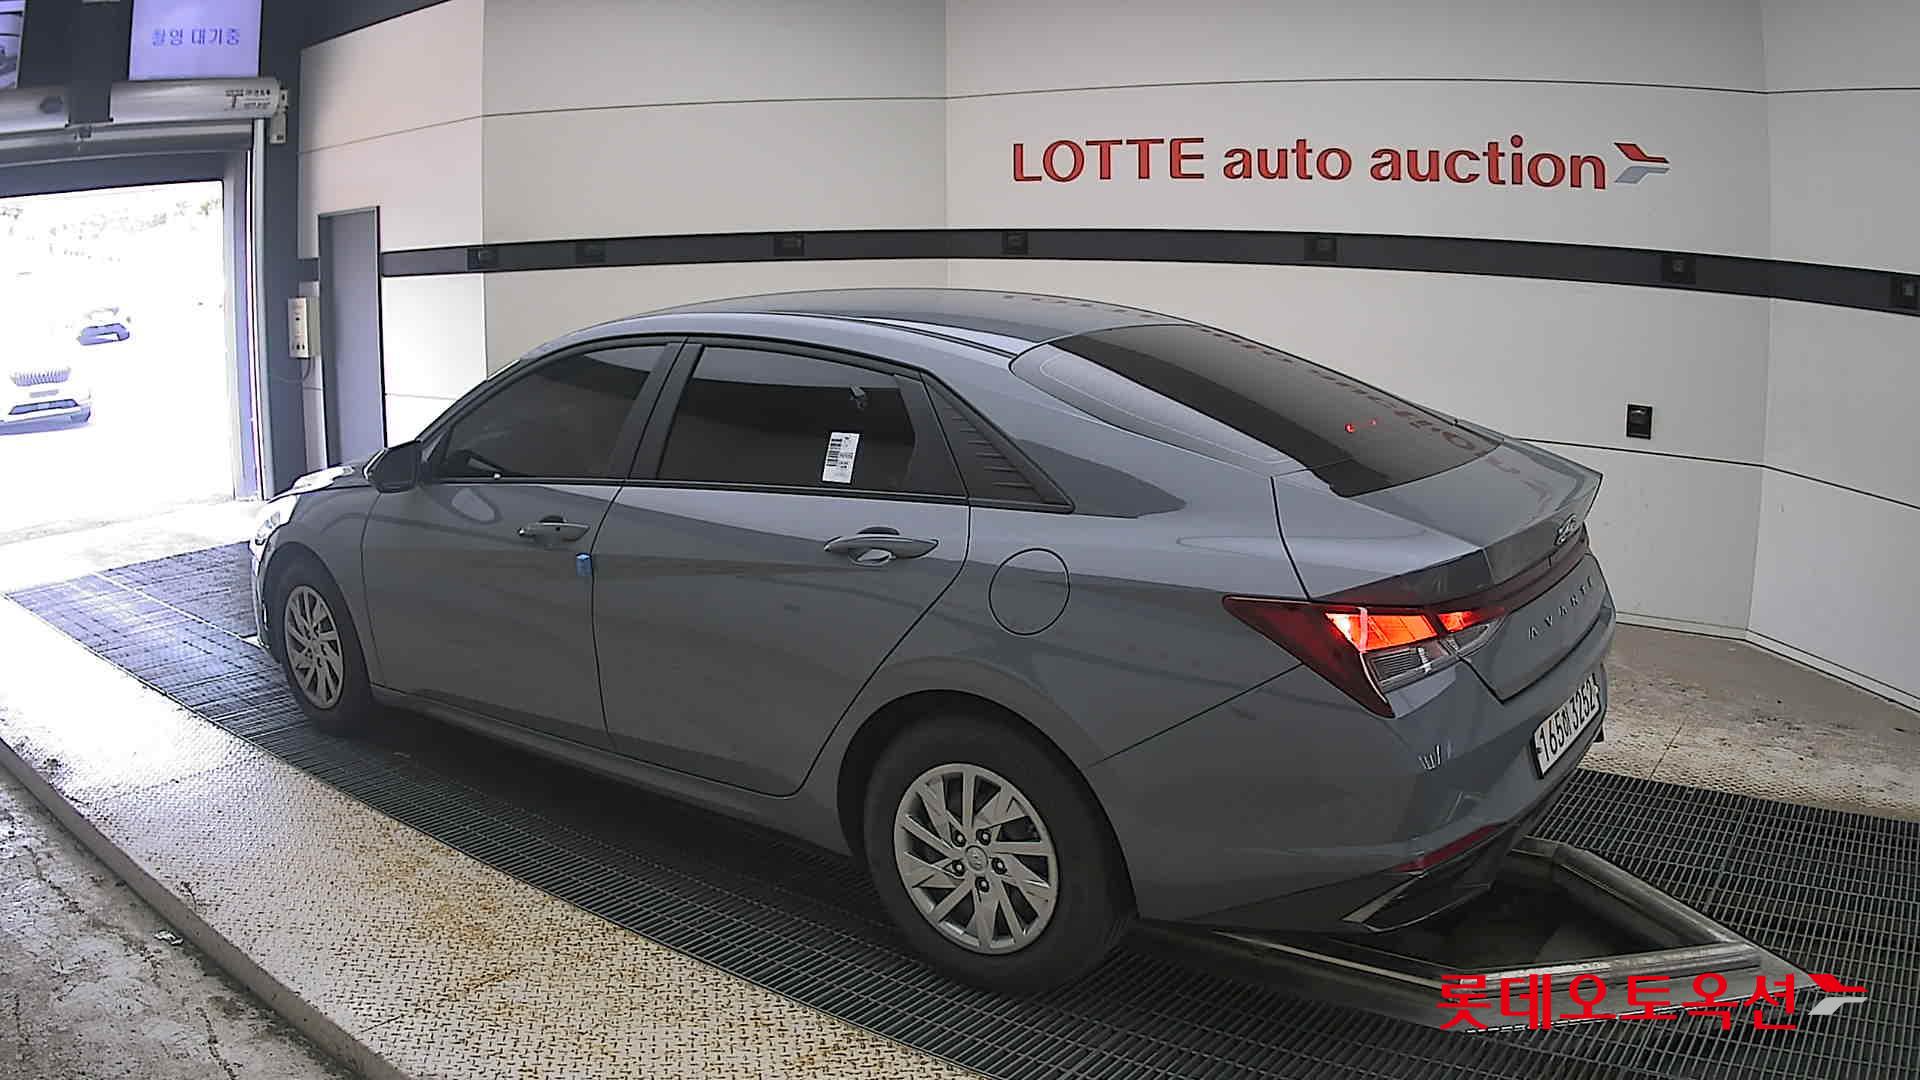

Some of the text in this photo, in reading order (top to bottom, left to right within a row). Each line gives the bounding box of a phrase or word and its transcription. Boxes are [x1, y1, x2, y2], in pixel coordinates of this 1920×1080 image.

[1013, 134, 1606, 190] LOTTE auto auction
[1570, 679, 1596, 731] 3252
